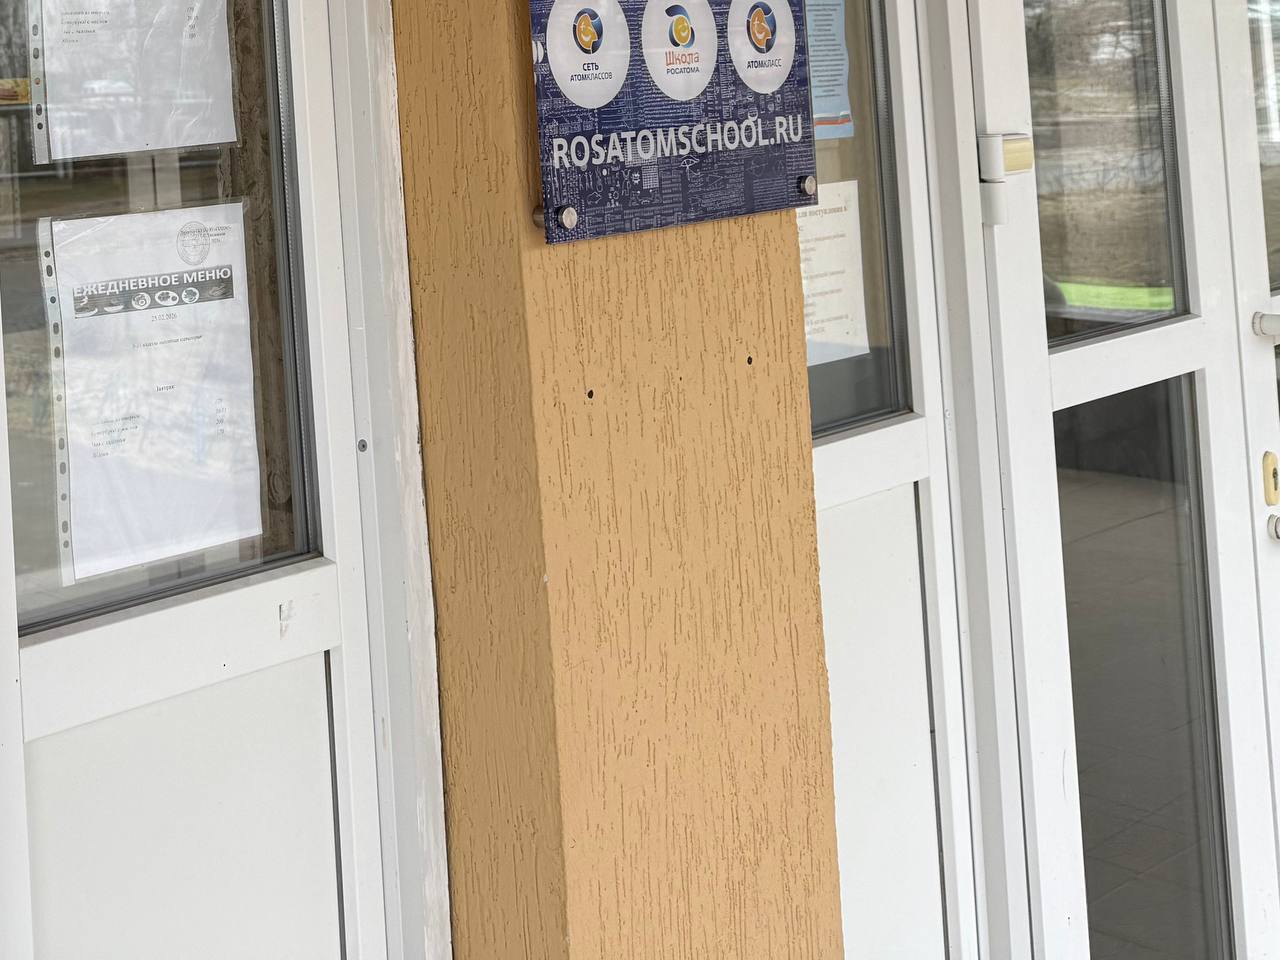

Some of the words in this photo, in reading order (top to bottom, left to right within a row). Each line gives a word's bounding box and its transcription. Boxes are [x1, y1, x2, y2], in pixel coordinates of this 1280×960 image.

[665, 50, 700, 67] Школа
[747, 58, 782, 69] АТОМКЛАСС
[582, 62, 599, 72] СЕТЬ
[667, 66, 700, 75] РОСАТОМА
[570, 72, 612, 82] АТОМКЛАССОВ
[552, 114, 802, 168] ROSATOMSCHOOL.RU
[73, 274, 179, 296] ЕЖЕДНЕВНОЕ
[183, 268, 231, 284] МЕНЮ
